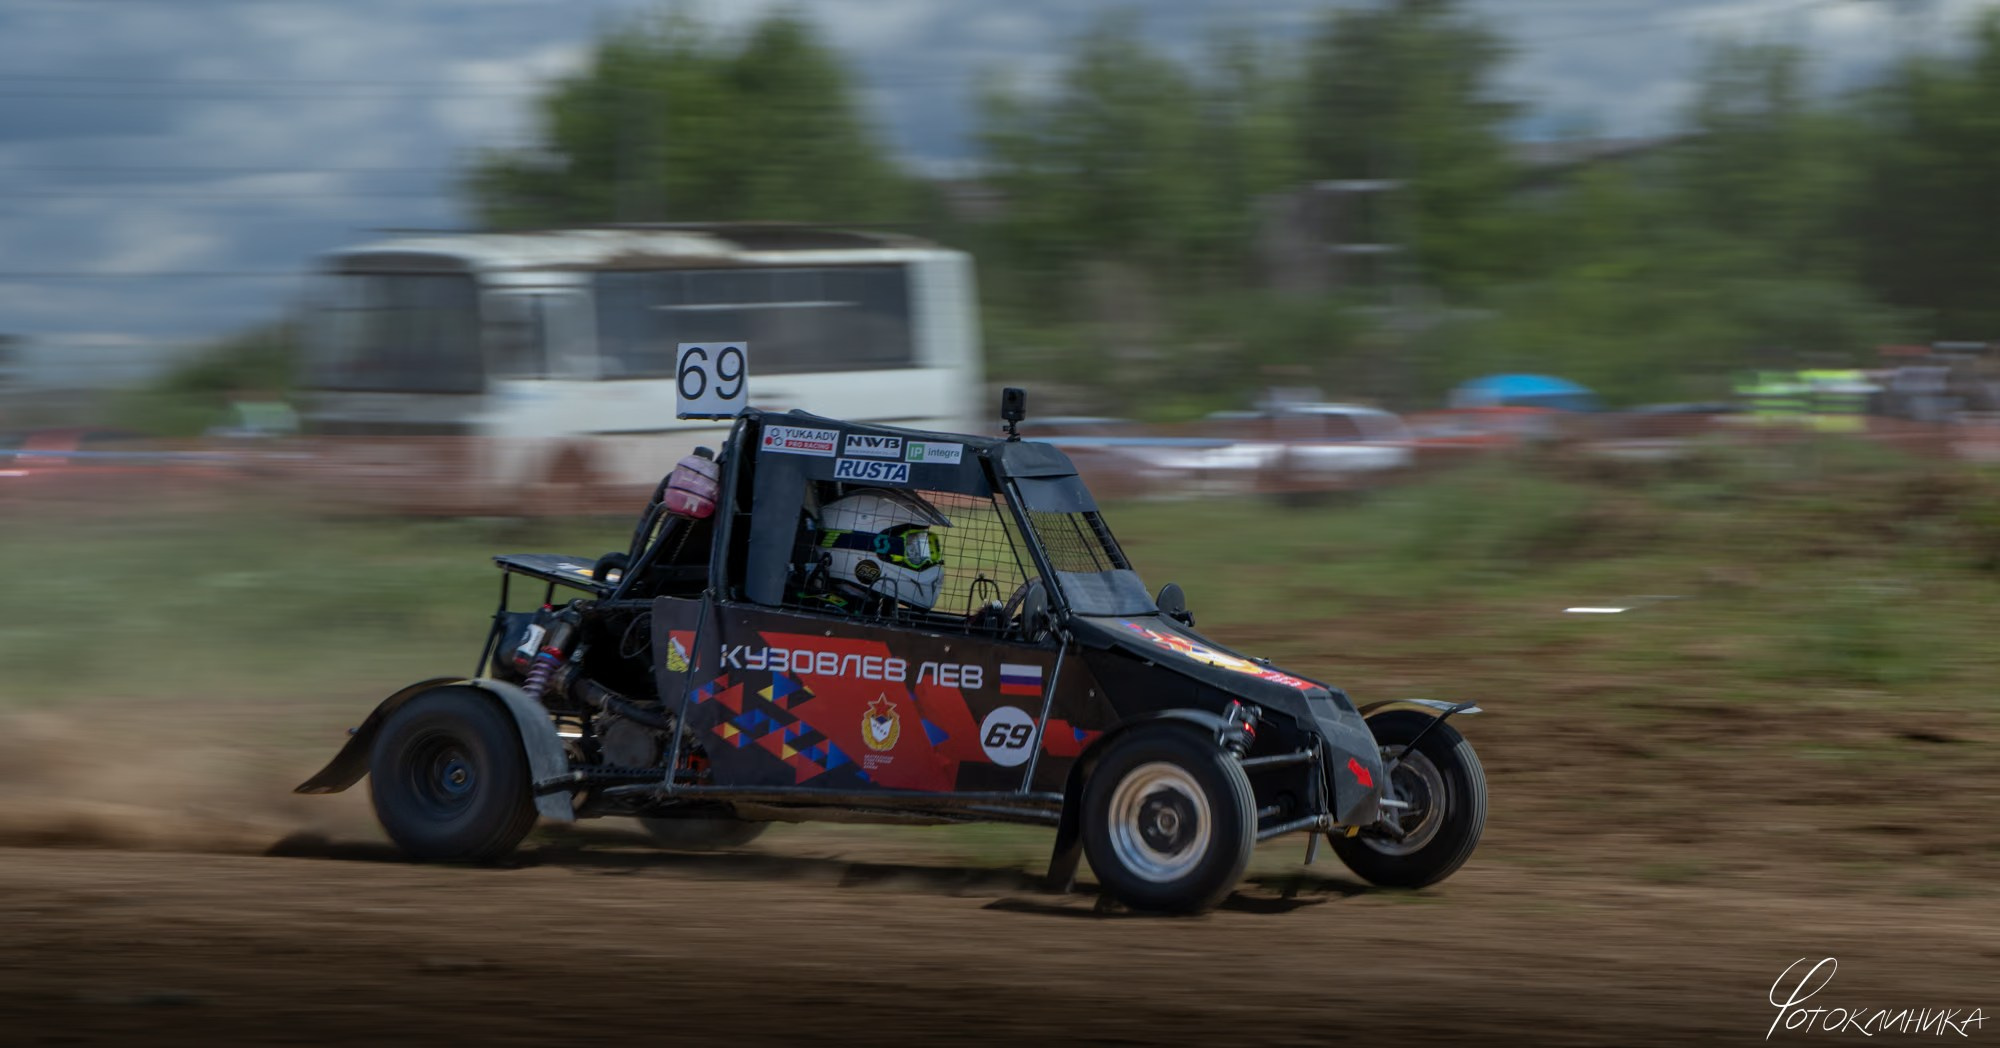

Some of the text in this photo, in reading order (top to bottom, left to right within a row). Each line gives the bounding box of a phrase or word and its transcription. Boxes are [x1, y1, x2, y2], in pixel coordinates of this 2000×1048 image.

[678, 346, 745, 400] 69
[785, 429, 838, 441] YUKA ADV
[847, 436, 900, 449] NWB
[803, 442, 831, 450] RACING
[927, 447, 960, 459] integra
[836, 460, 907, 481] RUSTA
[720, 644, 983, 689] КУЗОВЛЕВ ЛЕВ
[984, 722, 1033, 749] 69
